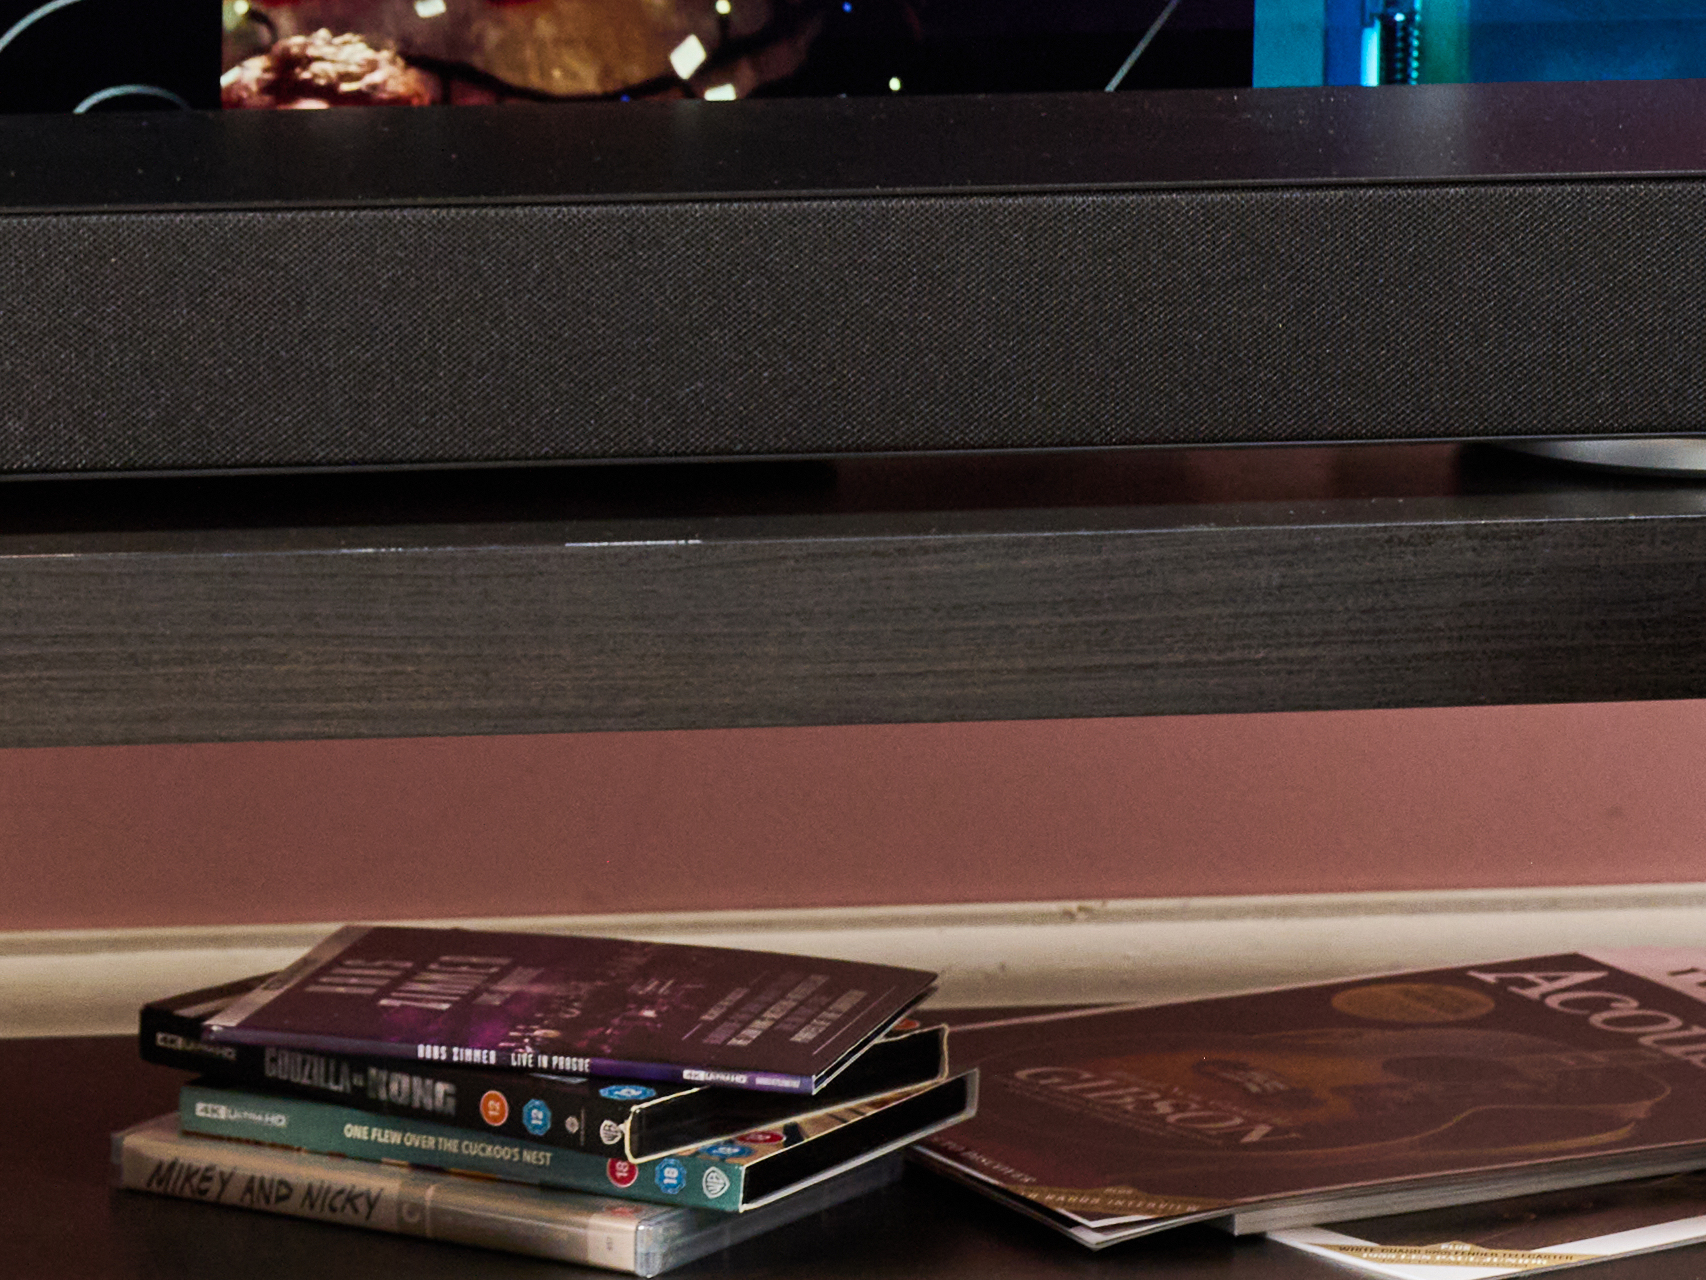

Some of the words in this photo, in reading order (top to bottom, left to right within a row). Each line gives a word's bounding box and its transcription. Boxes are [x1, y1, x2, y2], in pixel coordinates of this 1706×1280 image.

[343, 1123, 369, 1141] ONE
[370, 1127, 403, 1145] FLEW
[403, 1132, 436, 1151] OVER
[437, 1136, 459, 1154] THE
[522, 1149, 552, 1166] NEST
[146, 1158, 235, 1201] MIKEY
[239, 1174, 293, 1206] AND
[301, 1181, 384, 1220] NICKY
[663, 1167, 679, 1185] 18
